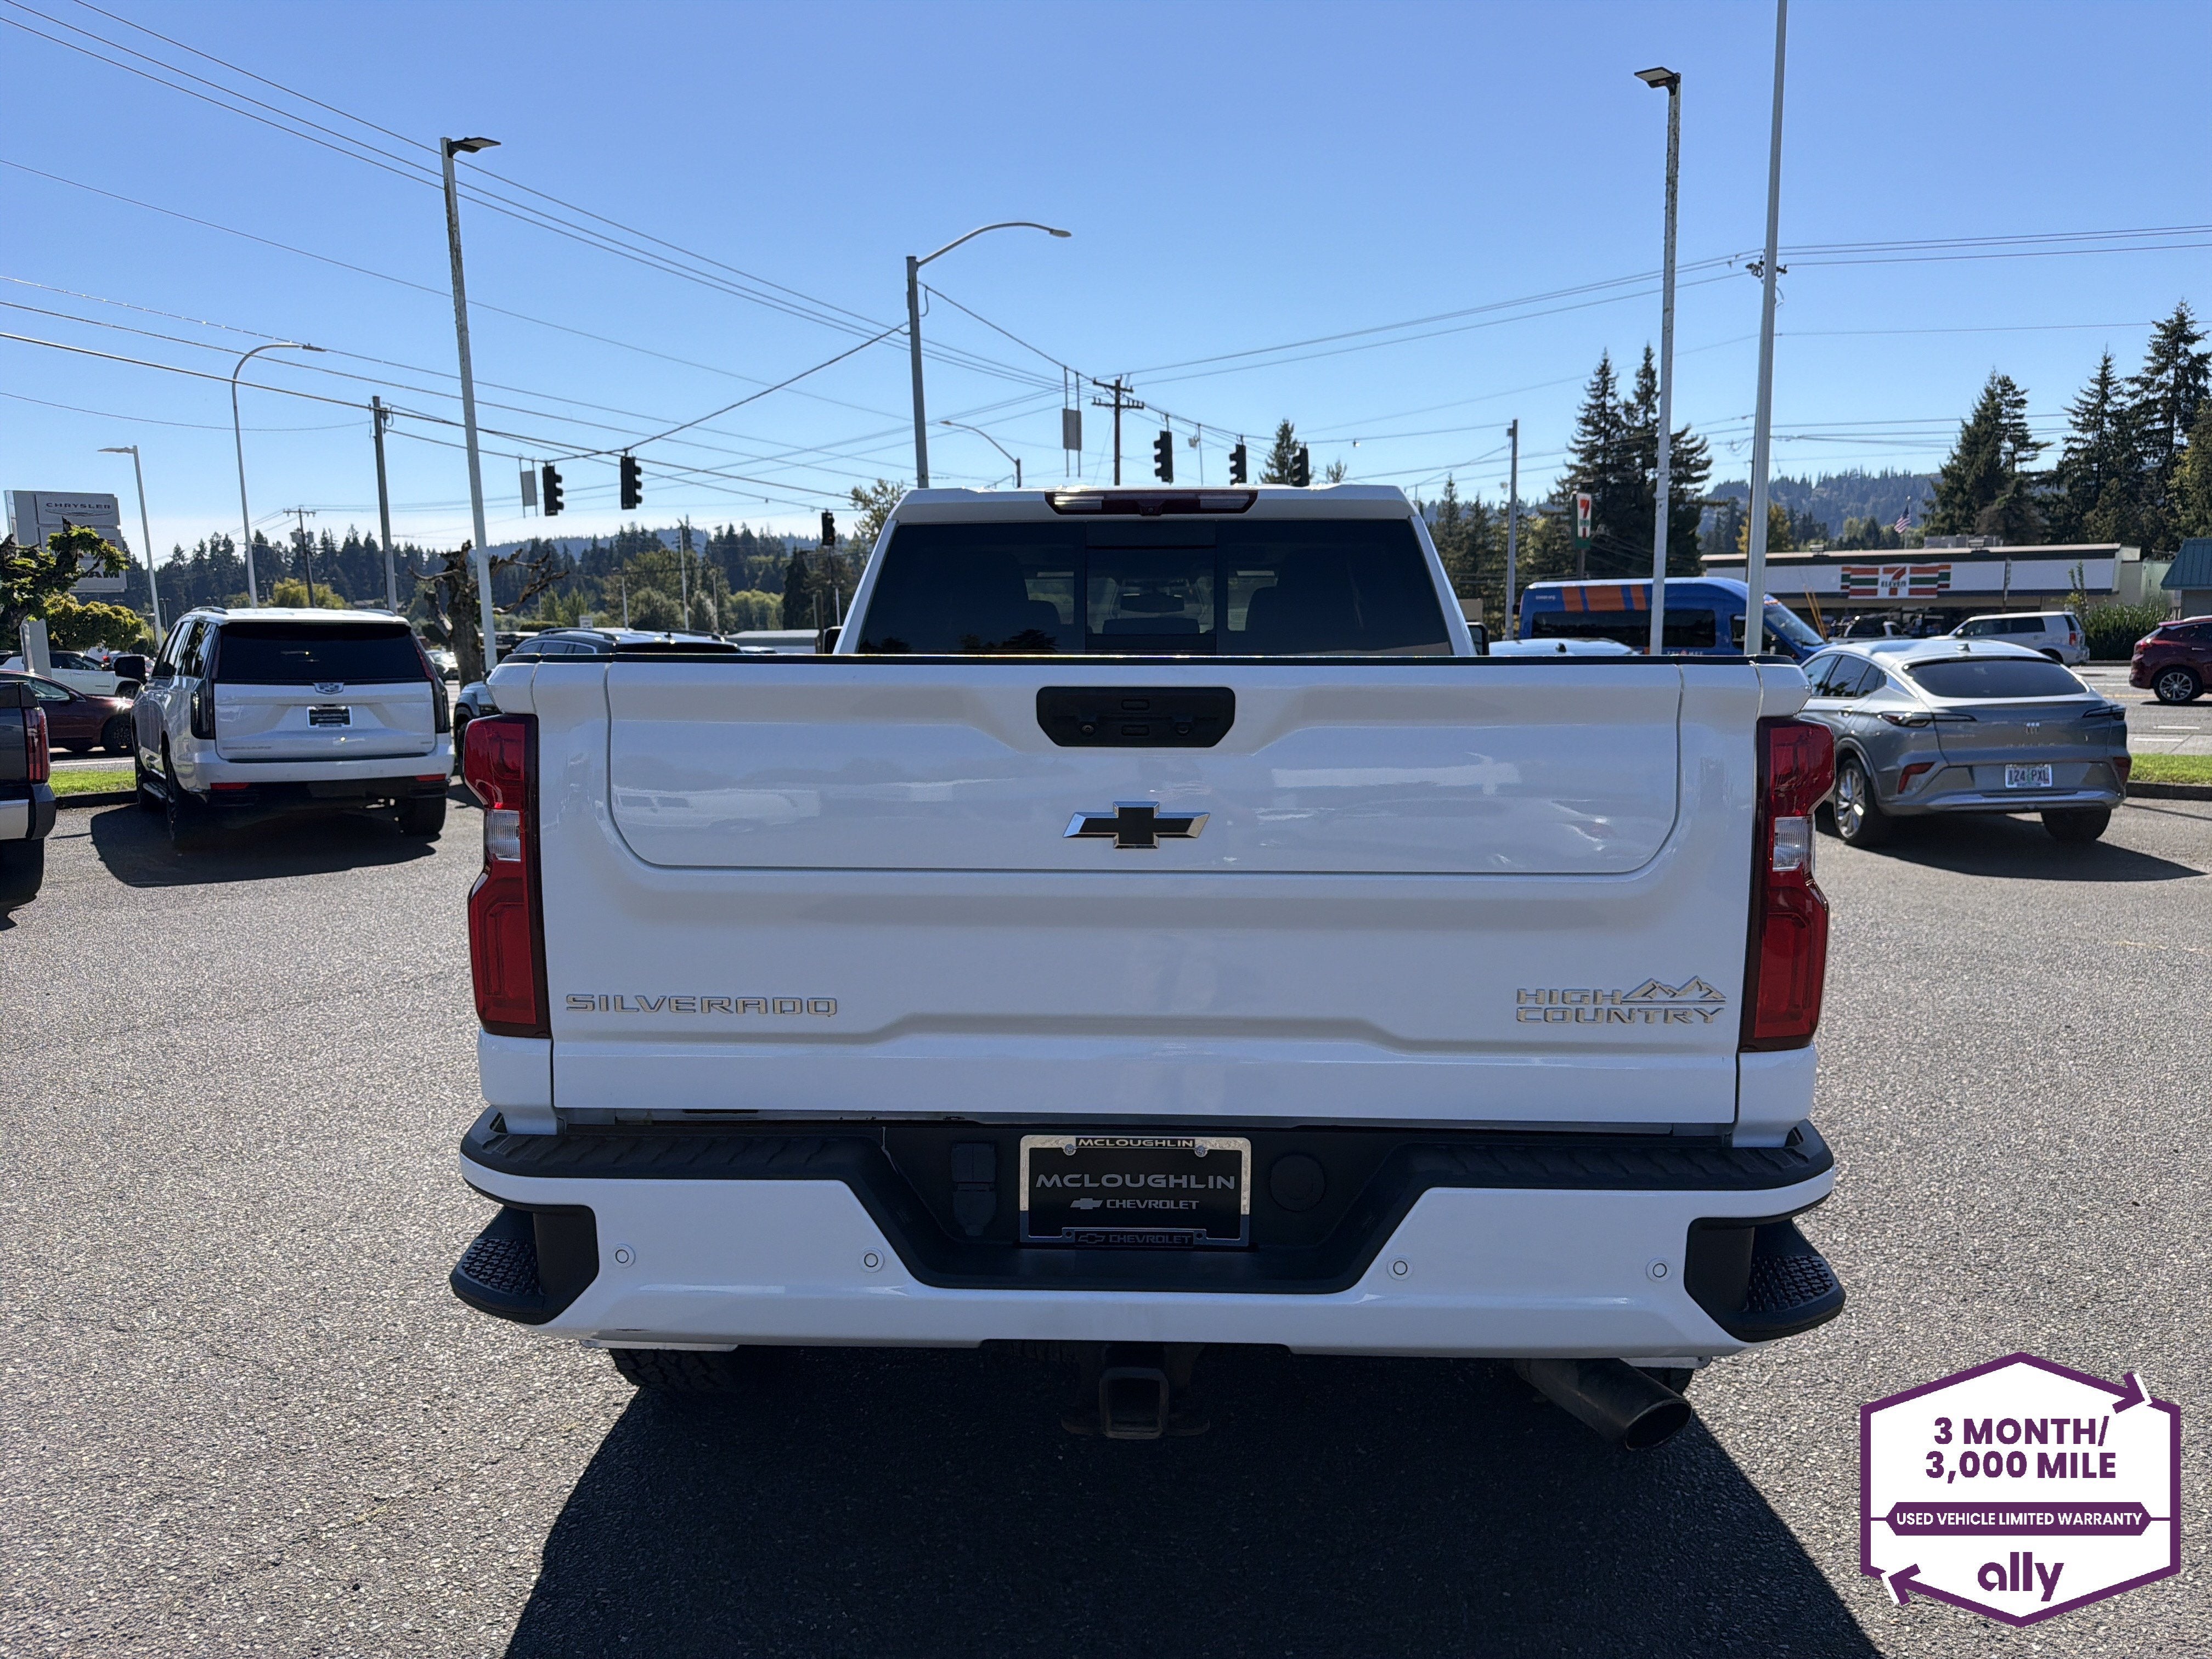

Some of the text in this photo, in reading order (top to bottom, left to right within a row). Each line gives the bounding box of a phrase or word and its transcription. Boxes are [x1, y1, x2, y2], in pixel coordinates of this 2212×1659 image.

[566, 994, 837, 1015] SILVERADO
[1517, 989, 1623, 1005] HIGH
[1516, 1007, 1724, 1024] COUNTRY
[1078, 1138, 1194, 1147] MCLOUGHLIN
[1036, 1173, 1235, 1189] MCLOUGHLIN
[1107, 1199, 1200, 1210] CHEVROLET
[1109, 1234, 1192, 1244] CHEVROLET
